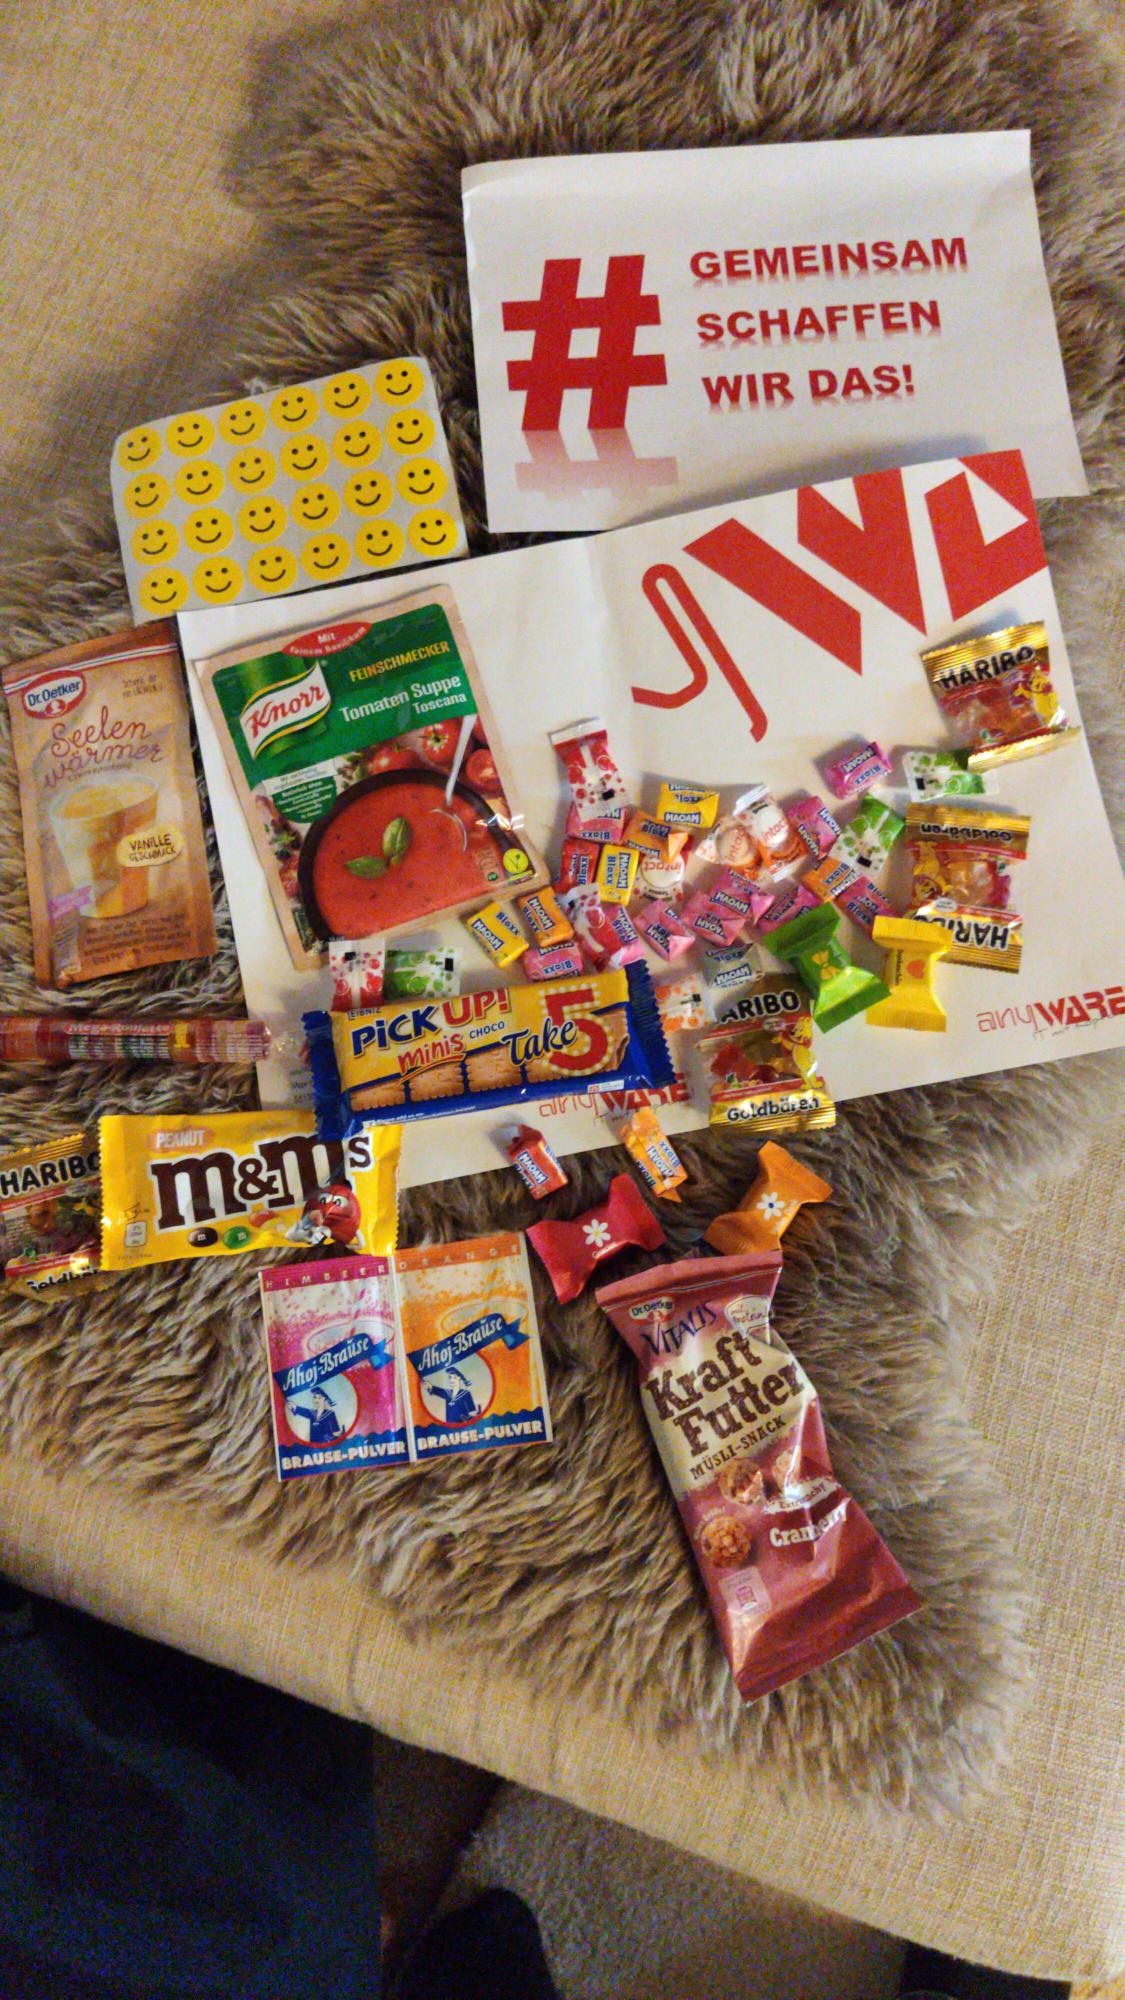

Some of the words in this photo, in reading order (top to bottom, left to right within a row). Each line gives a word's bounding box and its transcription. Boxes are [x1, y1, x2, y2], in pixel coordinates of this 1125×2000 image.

[690, 238, 968, 282] GEMEINSAM
[697, 300, 942, 343] SCHAFFEN
[702, 371, 794, 408] WIR
[808, 364, 915, 400] DAS!
[349, 640, 451, 684] FEINSCHMECKER
[937, 646, 1036, 691] HARIBO
[245, 683, 326, 740] Knorr
[339, 690, 410, 724] Tomaten
[411, 674, 462, 699] Suppe
[413, 691, 468, 716] Toscana
[51, 705, 150, 759] Seelen
[43, 740, 166, 791] wärmer
[664, 812, 701, 825] MAOAM
[920, 823, 1014, 843] Goldbären
[578, 855, 589, 886] Bloxx
[606, 856, 617, 886] Bloxx
[616, 852, 631, 889] MAOAM
[522, 907, 540, 933] Bloxx
[527, 896, 555, 931] MAOAM
[711, 892, 751, 915] MAOAM
[472, 917, 504, 951] MAOAM
[496, 912, 519, 936] Bloxx
[544, 960, 573, 974] Bloxx
[716, 964, 752, 986] MAOAM
[442, 989, 510, 1027] UP!
[469, 1020, 505, 1039] CHOCO
[501, 1017, 577, 1066] Take
[544, 988, 609, 1070] 5
[397, 1033, 465, 1076] minis
[727, 1096, 820, 1122] Goldbären
[156, 1130, 205, 1149] PEANUT
[515, 1151, 549, 1186] MAOAM
[265, 1264, 386, 1290] HIMBEER
[640, 1301, 717, 1356] VITALIS
[646, 1330, 763, 1421] Kraft
[673, 1361, 806, 1459] Futter
[417, 1420, 544, 1451] BRAUSE-PULVER
[690, 1415, 788, 1481] MÜSLI-SNACK
[281, 1440, 406, 1472] BRAUSE-PULVER
